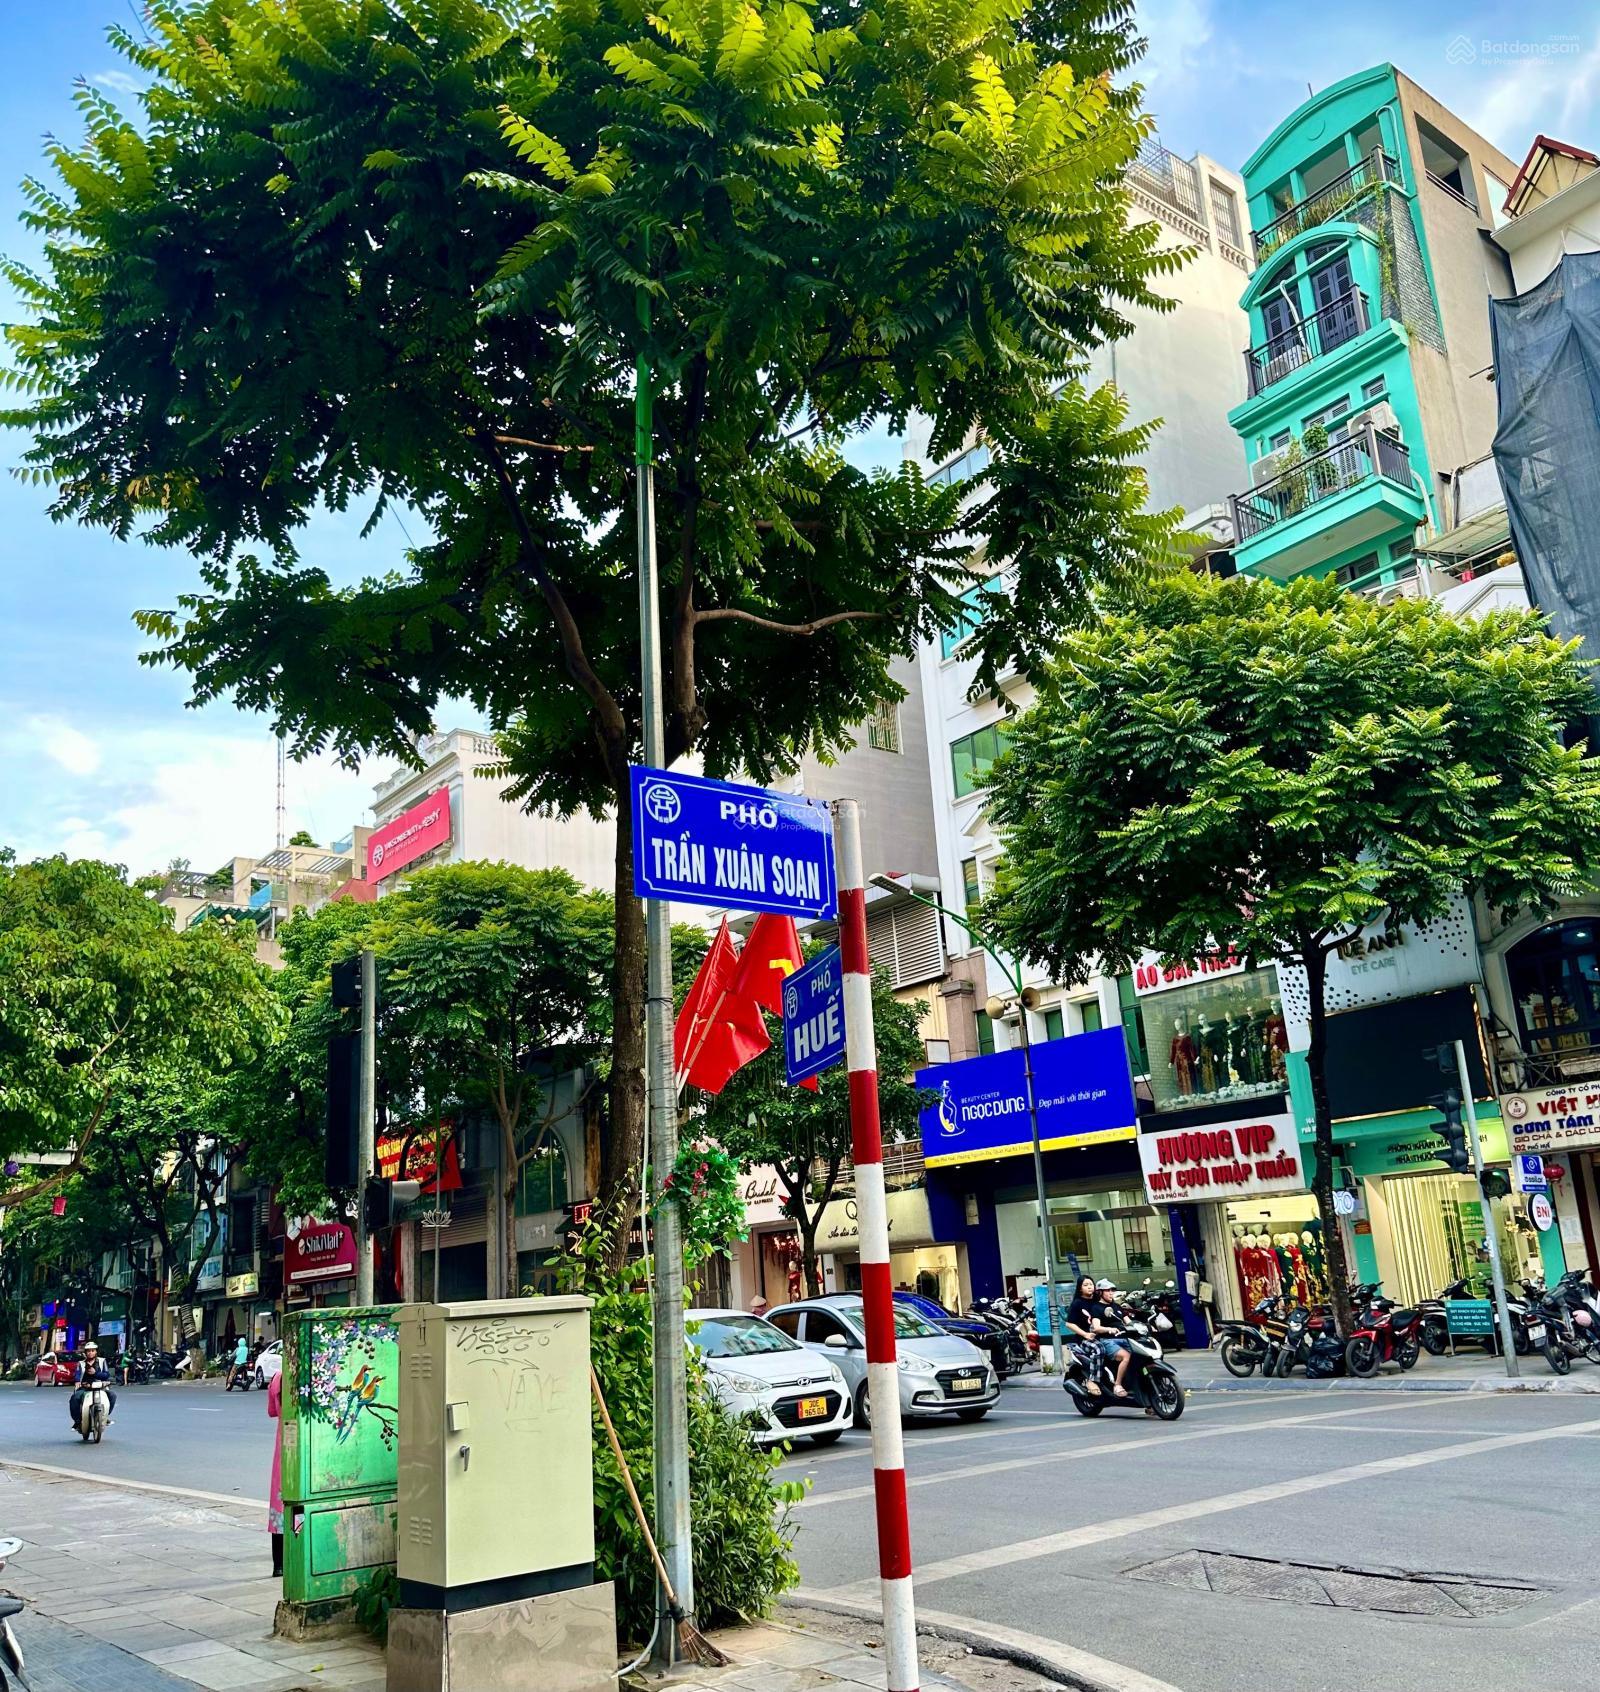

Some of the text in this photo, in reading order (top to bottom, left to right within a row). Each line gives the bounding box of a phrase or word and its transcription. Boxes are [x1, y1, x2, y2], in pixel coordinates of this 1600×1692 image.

[719, 801, 778, 828] PHỐ
[652, 830, 821, 906] TRẦN XUÂN SOẠN
[811, 960, 832, 999] PHỐ
[1136, 961, 1159, 989] ÁO
[1350, 956, 1397, 976] EYE CARE
[794, 987, 842, 1064] HUẾ
[961, 1091, 1000, 1104] BEAUTY CENTER
[1091, 1088, 1107, 1101] gian
[1537, 1095, 1579, 1116] VIỆT
[1512, 1114, 1594, 1135] CƠM TÁM
[1235, 1125, 1276, 1156] VIP
[1513, 1144, 1526, 1152] 102
[1148, 1167, 1172, 1191] VÁY
[1211, 1160, 1253, 1187] NHẬP
[1255, 1149, 1297, 1181] KHẨU
